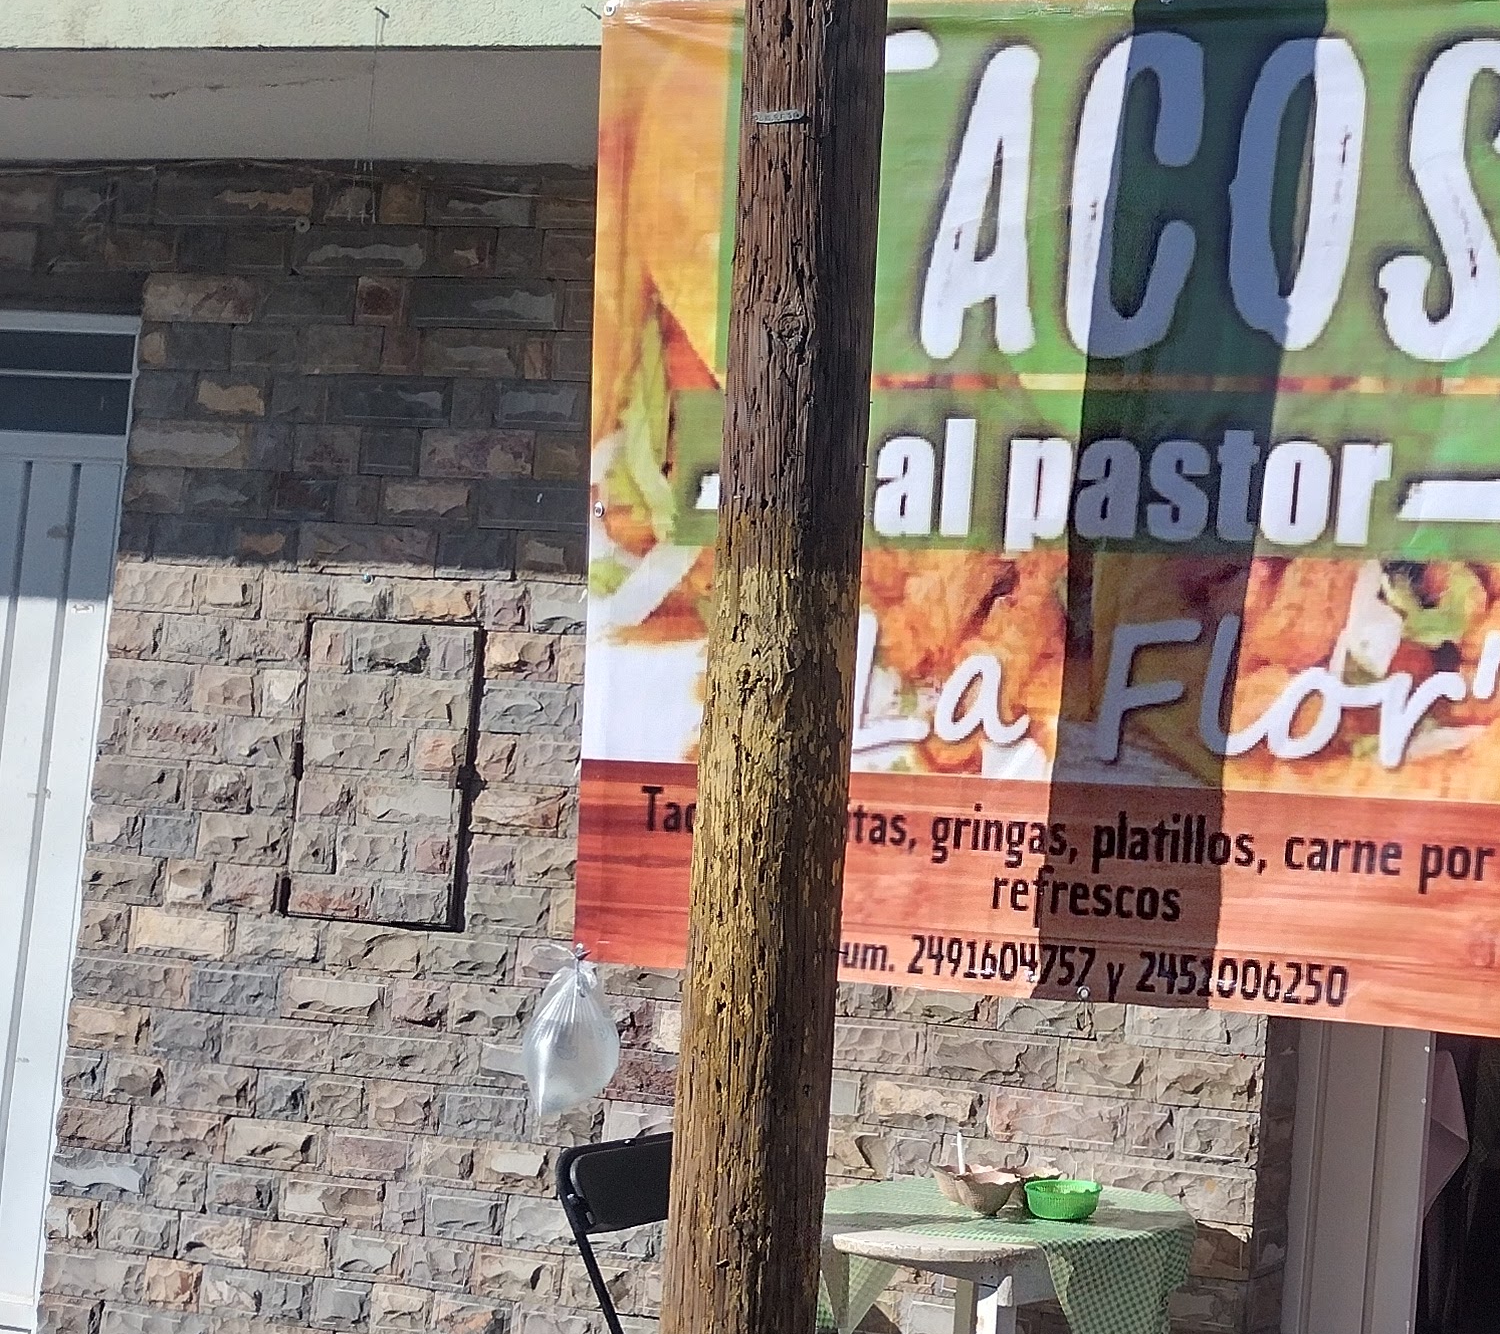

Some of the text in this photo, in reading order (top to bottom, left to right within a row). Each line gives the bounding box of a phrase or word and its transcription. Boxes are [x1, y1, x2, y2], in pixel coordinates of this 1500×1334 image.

[873, 418, 1393, 553] al pastor
[930, 803, 1079, 867] gringas,
[1092, 811, 1267, 874] platillos,
[1284, 835, 1402, 876] carne
[1418, 841, 1496, 894] por
[990, 868, 1181, 927] refrescos
[842, 941, 896, 973] um.
[907, 933, 1097, 989] 2491604757
[1107, 960, 1125, 1002] y
